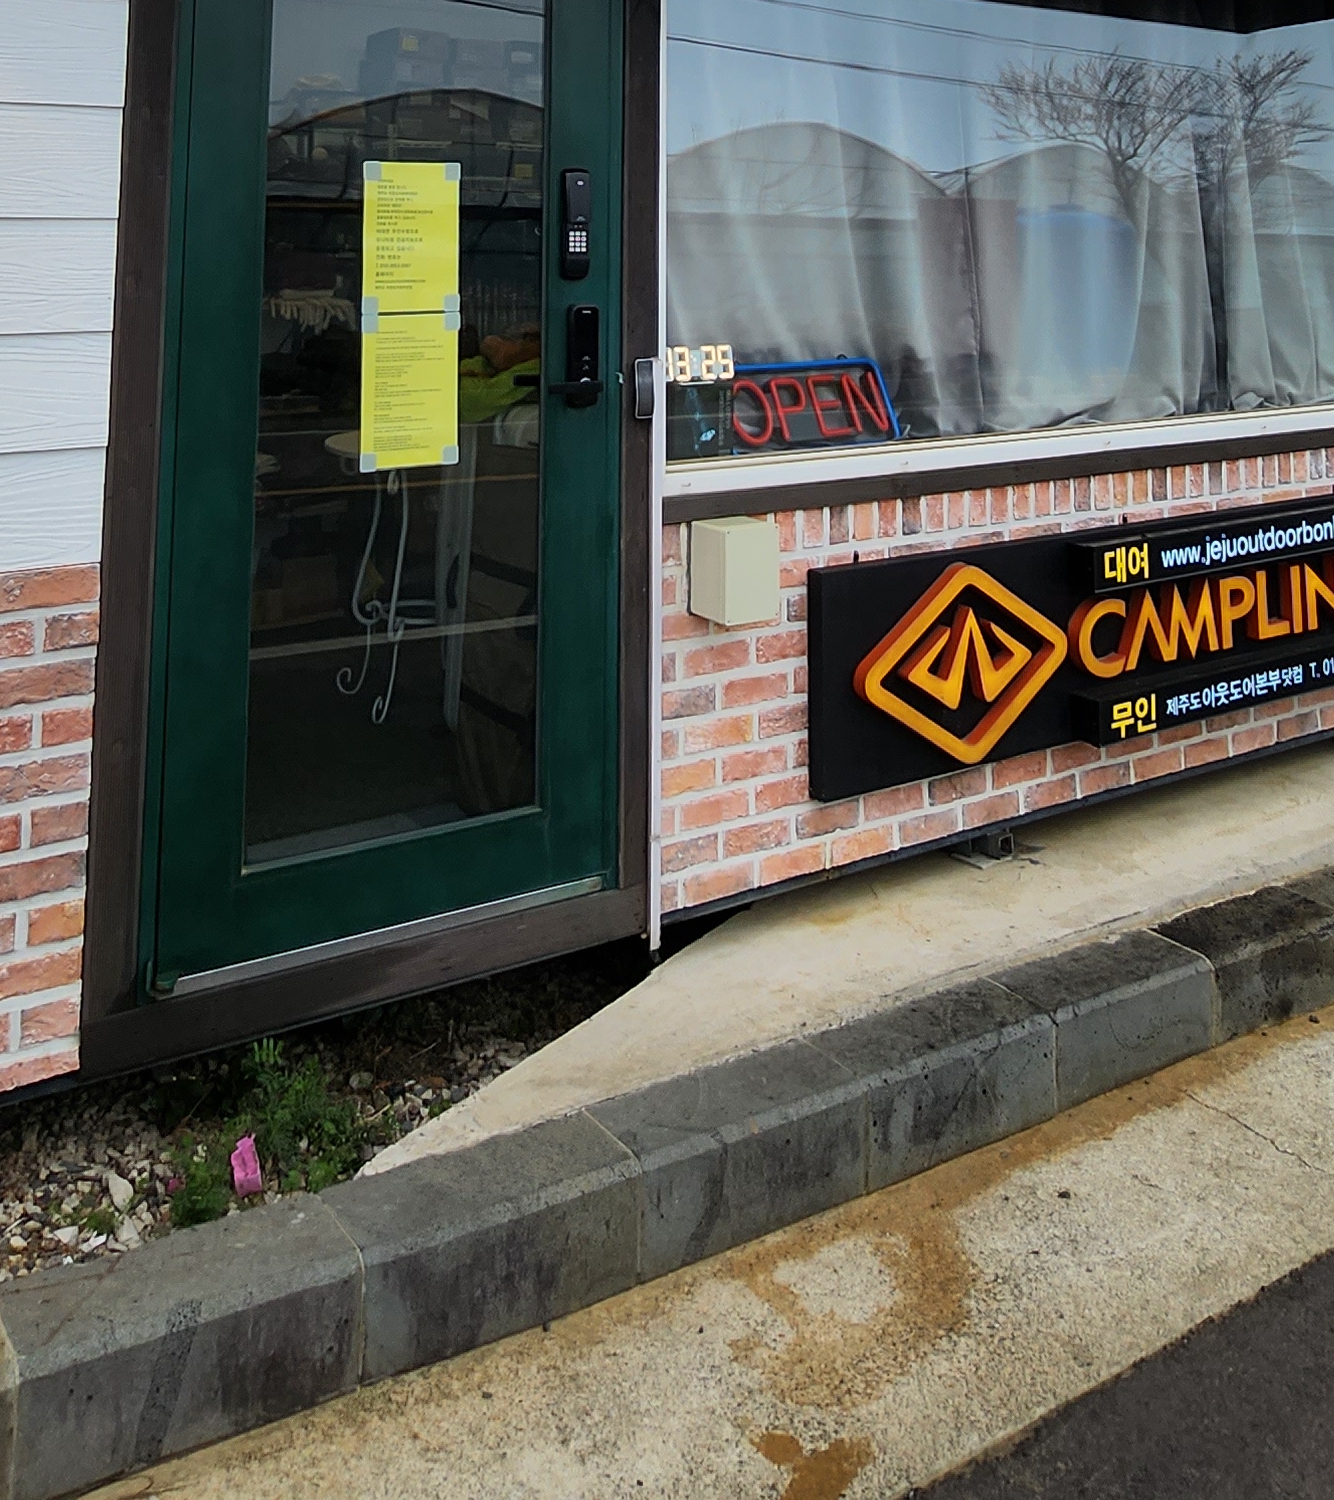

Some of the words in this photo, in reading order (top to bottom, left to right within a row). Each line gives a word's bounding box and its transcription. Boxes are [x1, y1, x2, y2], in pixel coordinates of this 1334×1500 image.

[731, 370, 890, 447] OPEN
[1103, 542, 1150, 583] 대여
[1110, 693, 1157, 739] 무인
